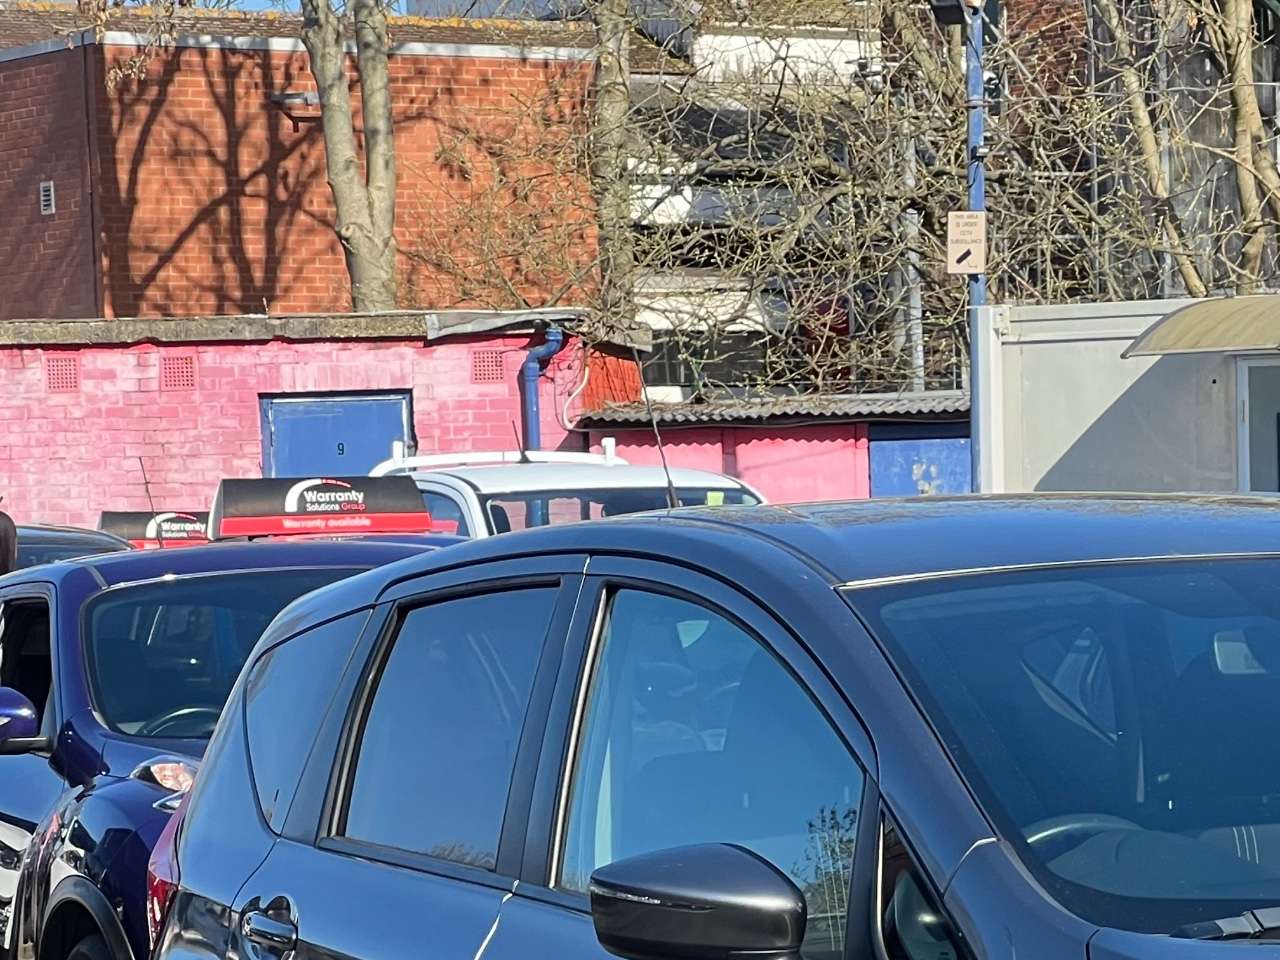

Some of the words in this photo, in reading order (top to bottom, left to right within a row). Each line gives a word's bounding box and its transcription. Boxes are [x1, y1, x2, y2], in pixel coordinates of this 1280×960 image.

[337, 442, 345, 456] 9
[303, 490, 365, 504] Warranty
[306, 503, 340, 512] Solutions
[341, 503, 366, 512] Group
[161, 522, 206, 533] Warranty
[282, 518, 325, 529] Warranty
[327, 517, 372, 527] available
